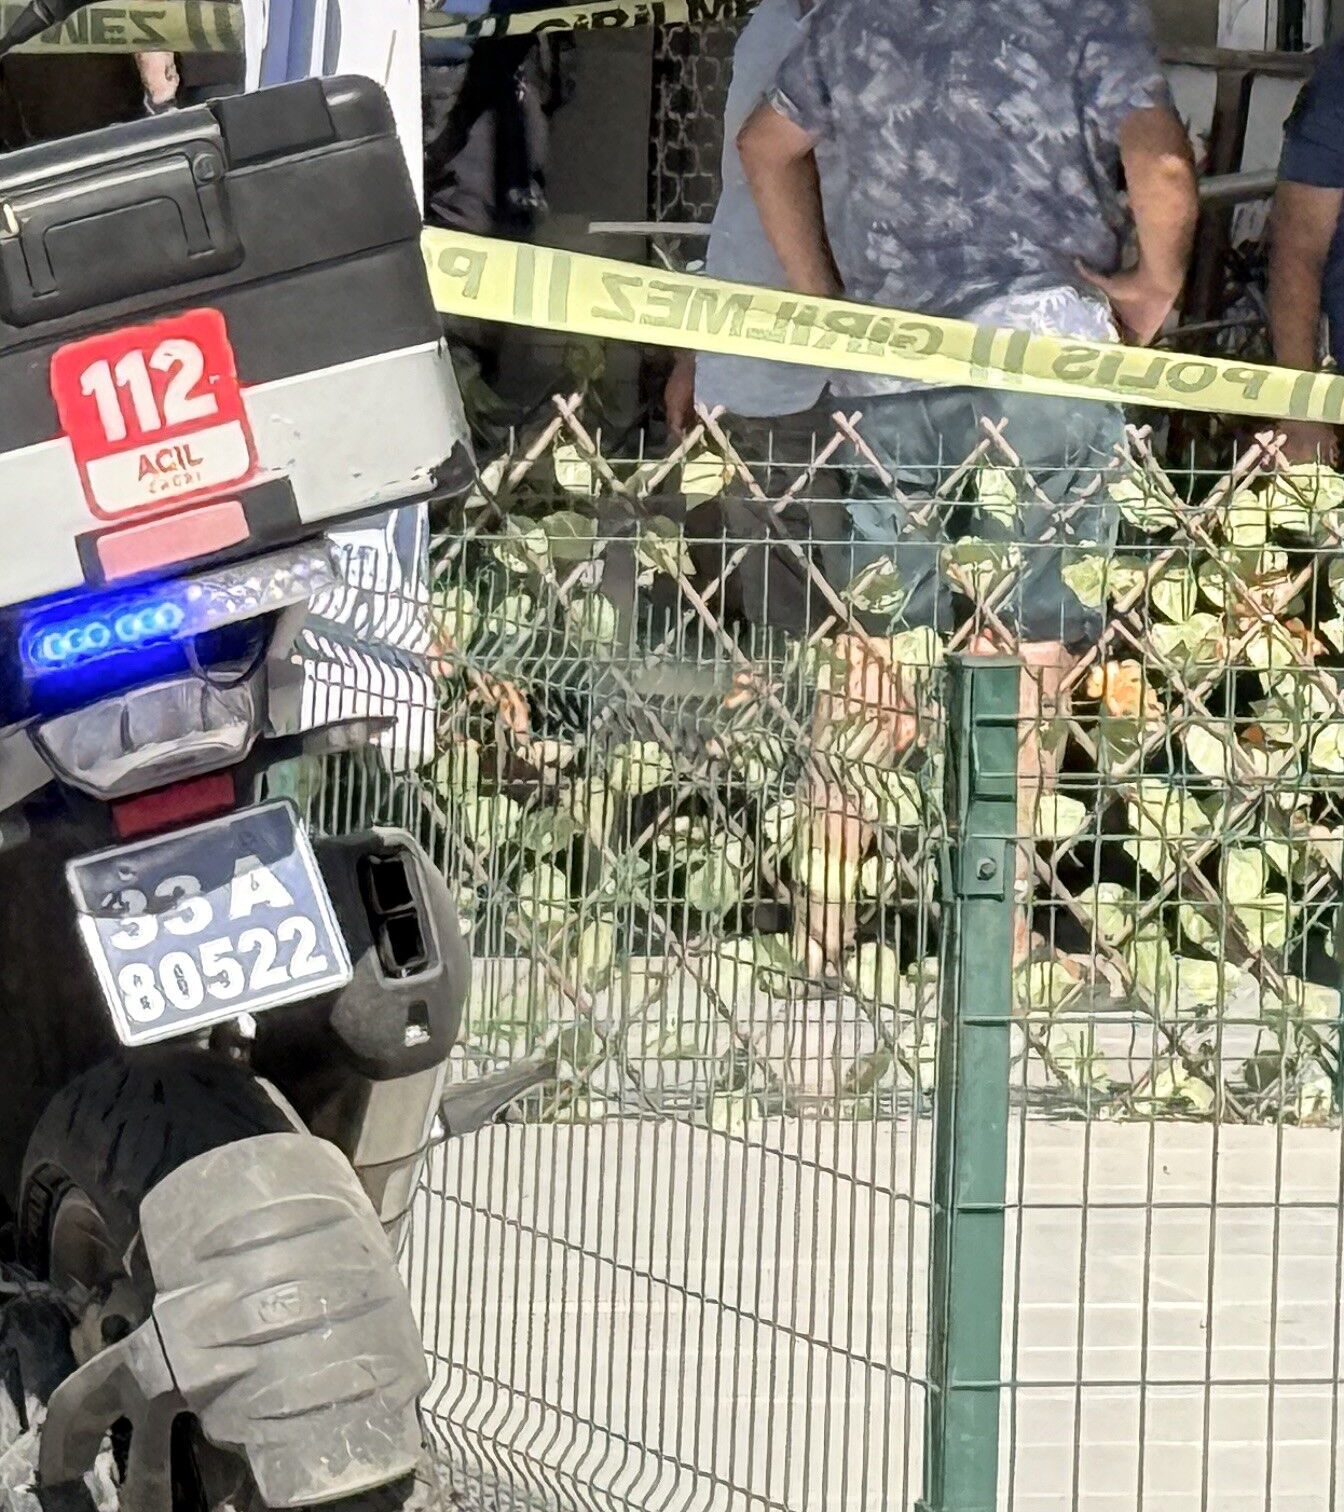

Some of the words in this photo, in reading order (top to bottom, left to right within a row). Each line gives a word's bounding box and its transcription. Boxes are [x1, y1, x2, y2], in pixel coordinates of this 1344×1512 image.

[79, 338, 220, 443] 112
[101, 874, 214, 951] 33
[230, 854, 295, 921] A
[117, 915, 329, 1023] 80522
